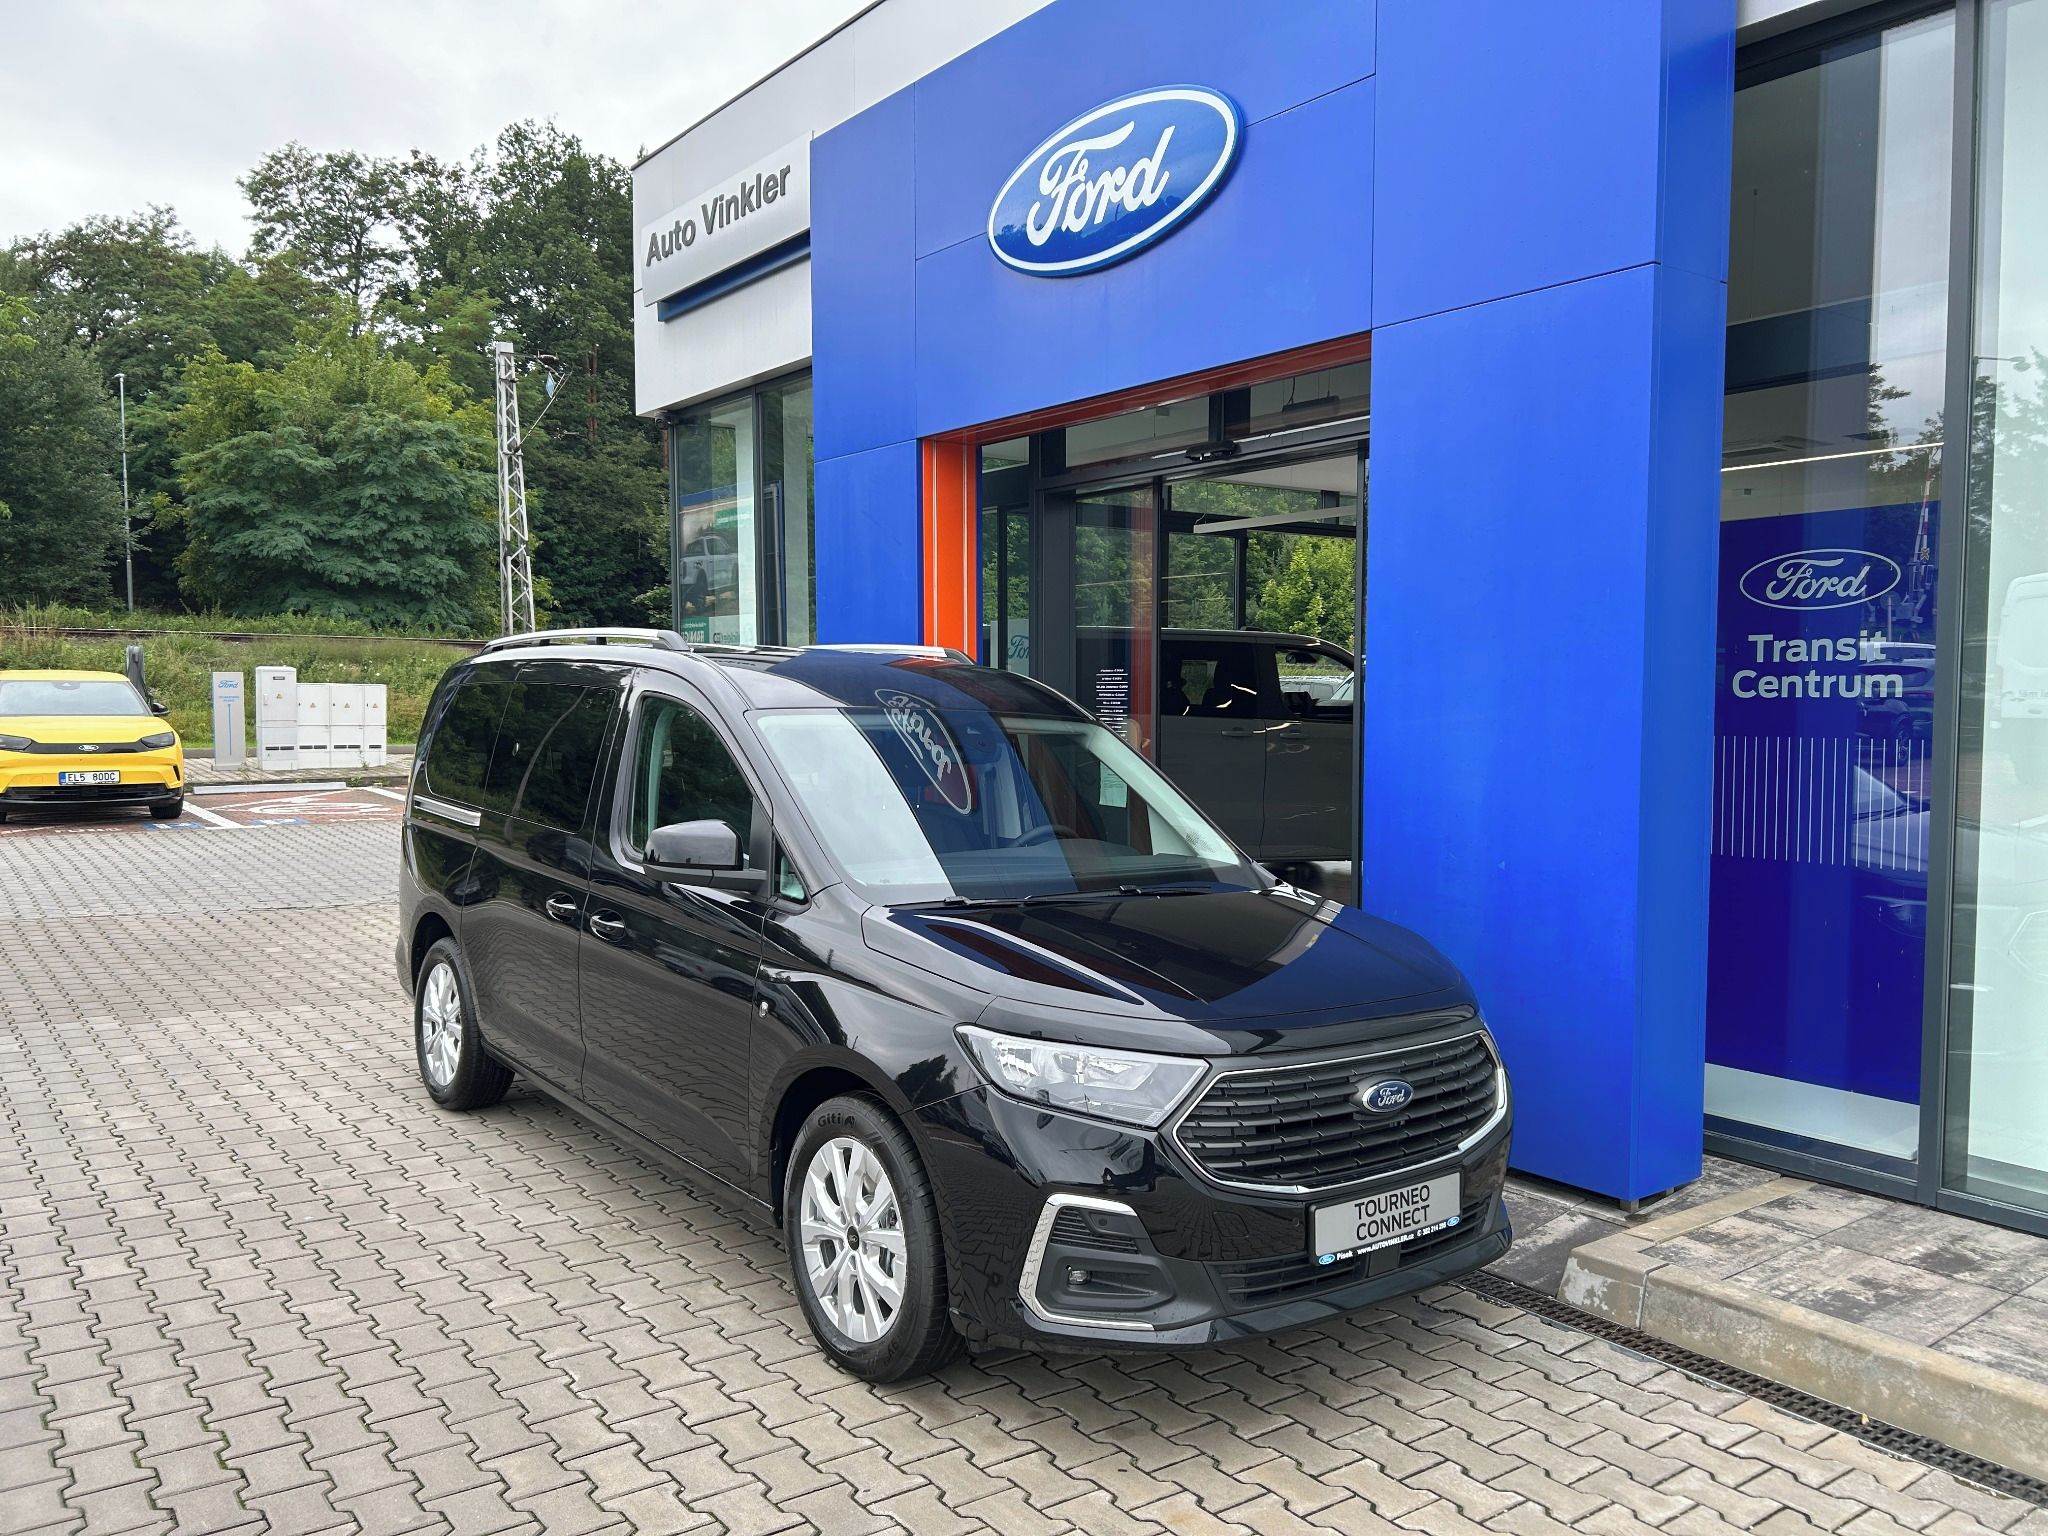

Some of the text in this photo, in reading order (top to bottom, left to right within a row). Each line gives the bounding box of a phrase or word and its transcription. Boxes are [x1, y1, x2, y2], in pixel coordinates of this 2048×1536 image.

[1026, 121, 1175, 247] Ford
[646, 164, 791, 267] Auto Vinkler
[1765, 557, 1871, 601] Ford
[1748, 629, 1887, 663] Transit
[217, 680, 239, 689] Ford
[1732, 666, 1903, 699] Centrum
[67, 773, 86, 782] EL5
[1377, 1086, 1405, 1107] Ford
[817, 1112, 841, 1127] Giti
[1354, 1184, 1430, 1220] TOURNEO
[1356, 1204, 1430, 1241] CONNECT
